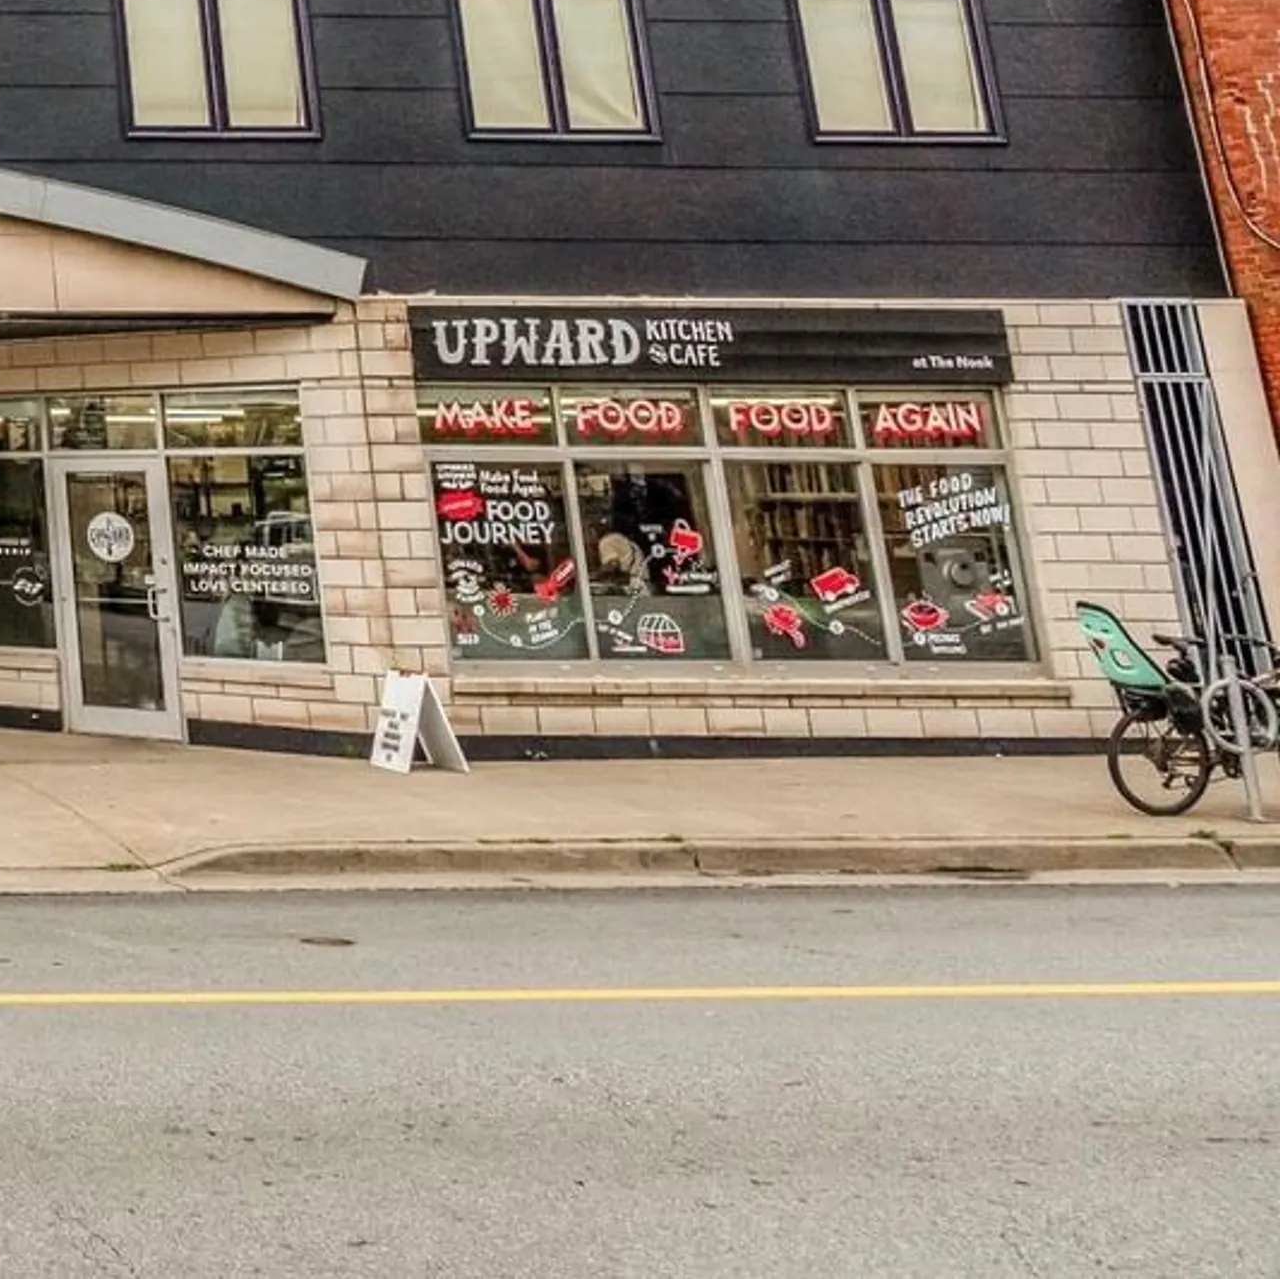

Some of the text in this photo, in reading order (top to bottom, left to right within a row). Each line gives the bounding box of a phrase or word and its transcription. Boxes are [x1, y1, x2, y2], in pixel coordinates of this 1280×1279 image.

[431, 318, 735, 366] UPWARD KITCHEN
[669, 343, 722, 367] CAFE
[928, 354, 954, 369] The
[434, 398, 982, 433] MAKE FOOD FOOD AGAIN
[898, 472, 973, 508] THE FOOD
[486, 500, 550, 522] FOOD
[906, 487, 997, 529] REVOLUTION
[441, 522, 555, 545] JOURNEY
[911, 503, 1011, 549] STARTS NOW!
[202, 545, 288, 559] CHEF MADE
[183, 562, 313, 578] IMPACT FOCUSED
[190, 579, 311, 595] LOVE CENTERED
